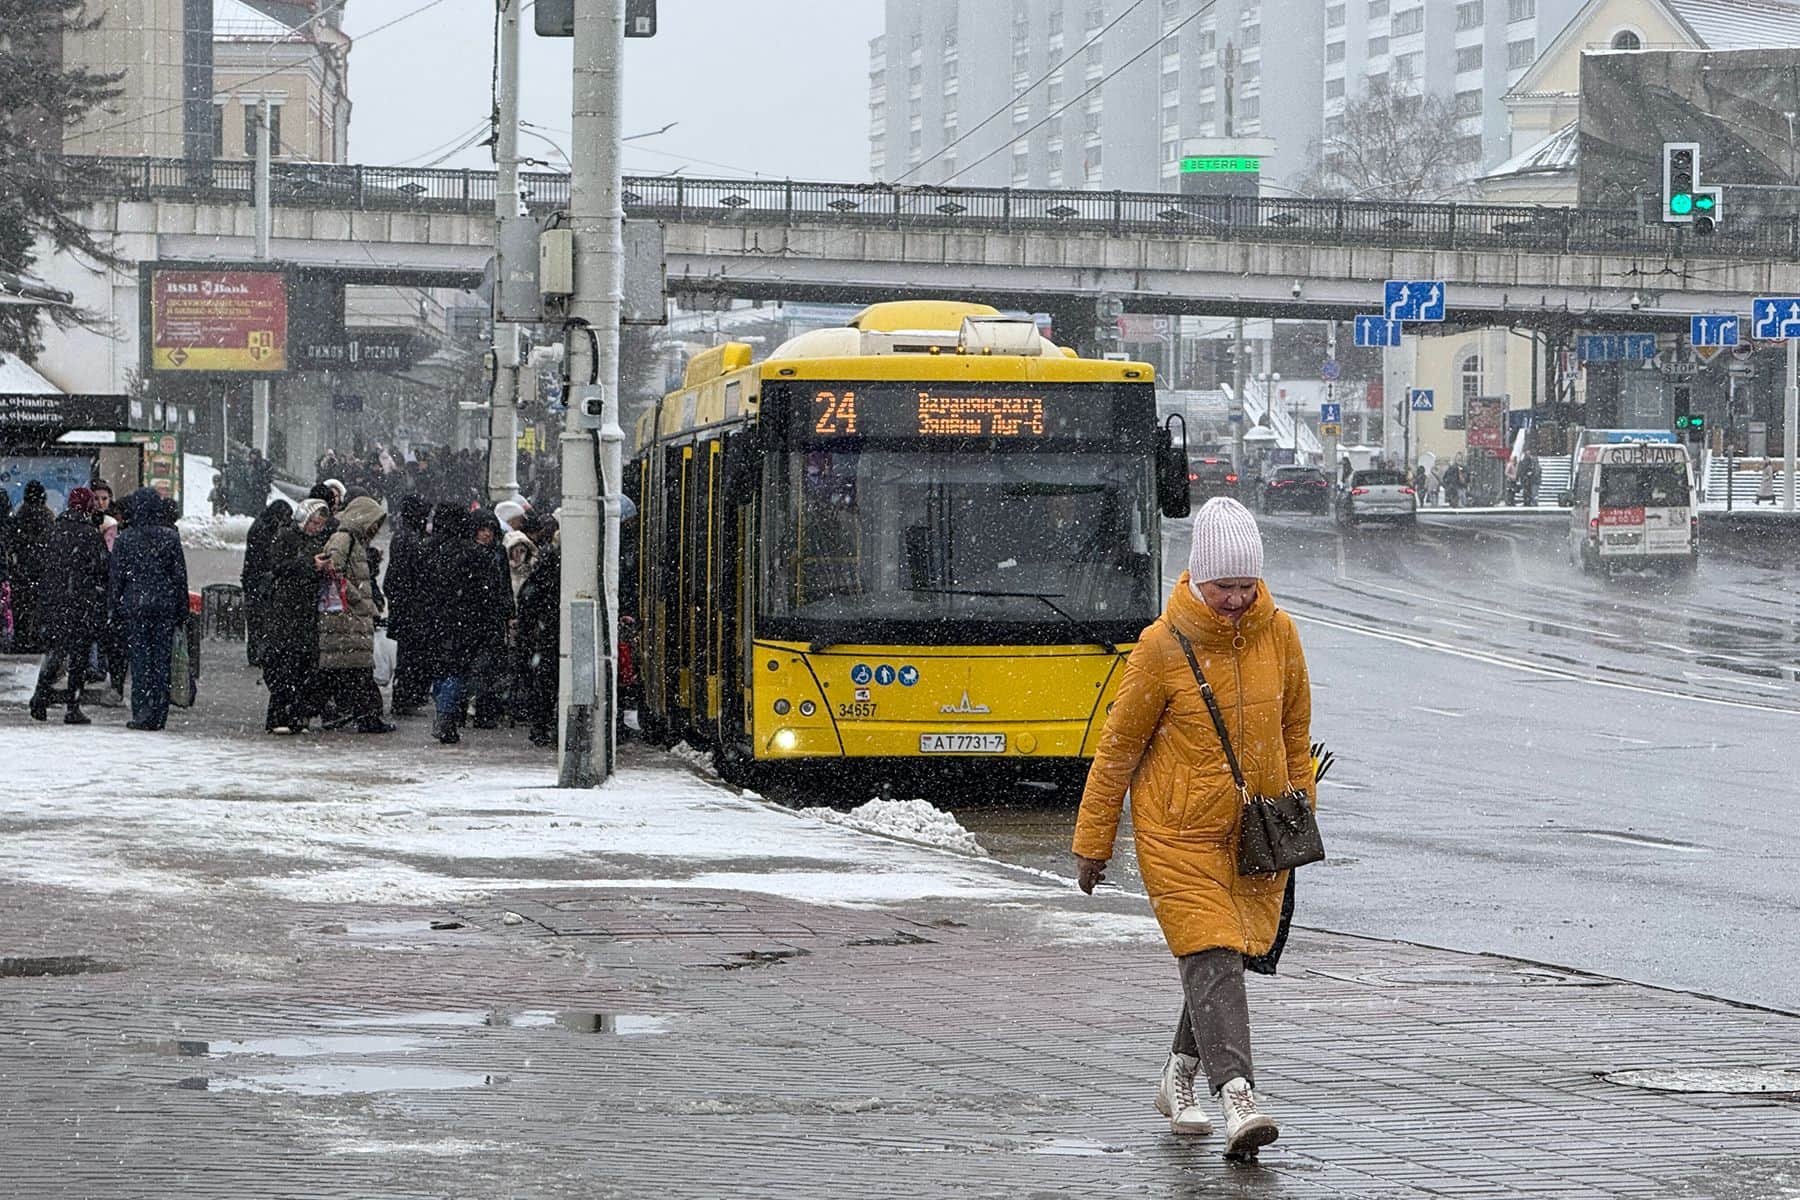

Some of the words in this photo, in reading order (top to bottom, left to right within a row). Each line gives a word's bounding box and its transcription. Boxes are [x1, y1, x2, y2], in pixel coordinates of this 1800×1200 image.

[167, 283, 199, 293] BSB
[213, 282, 249, 294] Bank
[1664, 364, 1695, 374] STOP
[918, 392, 1043, 414] Варанянскага
[815, 391, 857, 433] 24
[918, 413, 981, 434] Зялёны
[991, 413, 1044, 434] Луг-6
[1612, 448, 1676, 464] GURMAN
[839, 703, 877, 717] 34657
